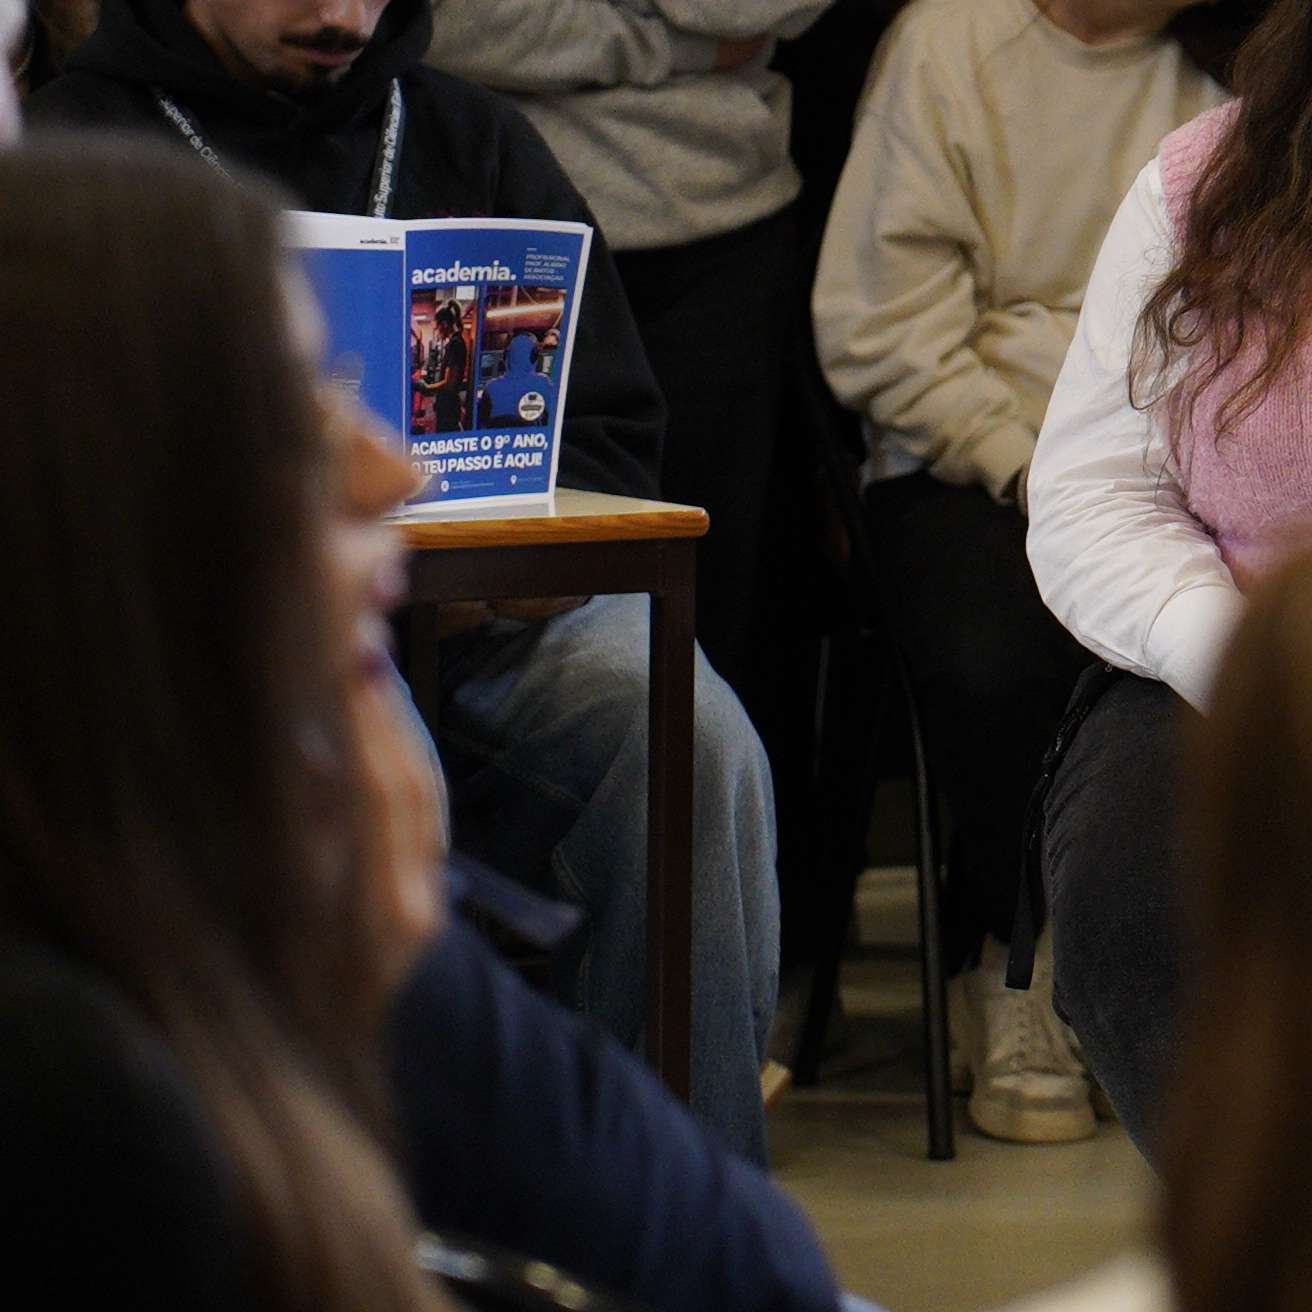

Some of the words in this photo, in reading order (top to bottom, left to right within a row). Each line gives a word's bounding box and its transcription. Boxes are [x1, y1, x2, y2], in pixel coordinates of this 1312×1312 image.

[411, 259, 517, 285] academia.
[410, 436, 479, 456] ACABASTE
[480, 435, 492, 451] O
[513, 433, 549, 450] ANO,
[423, 459, 447, 475] TEU
[448, 455, 492, 473] PASSO
[493, 451, 504, 468] É
